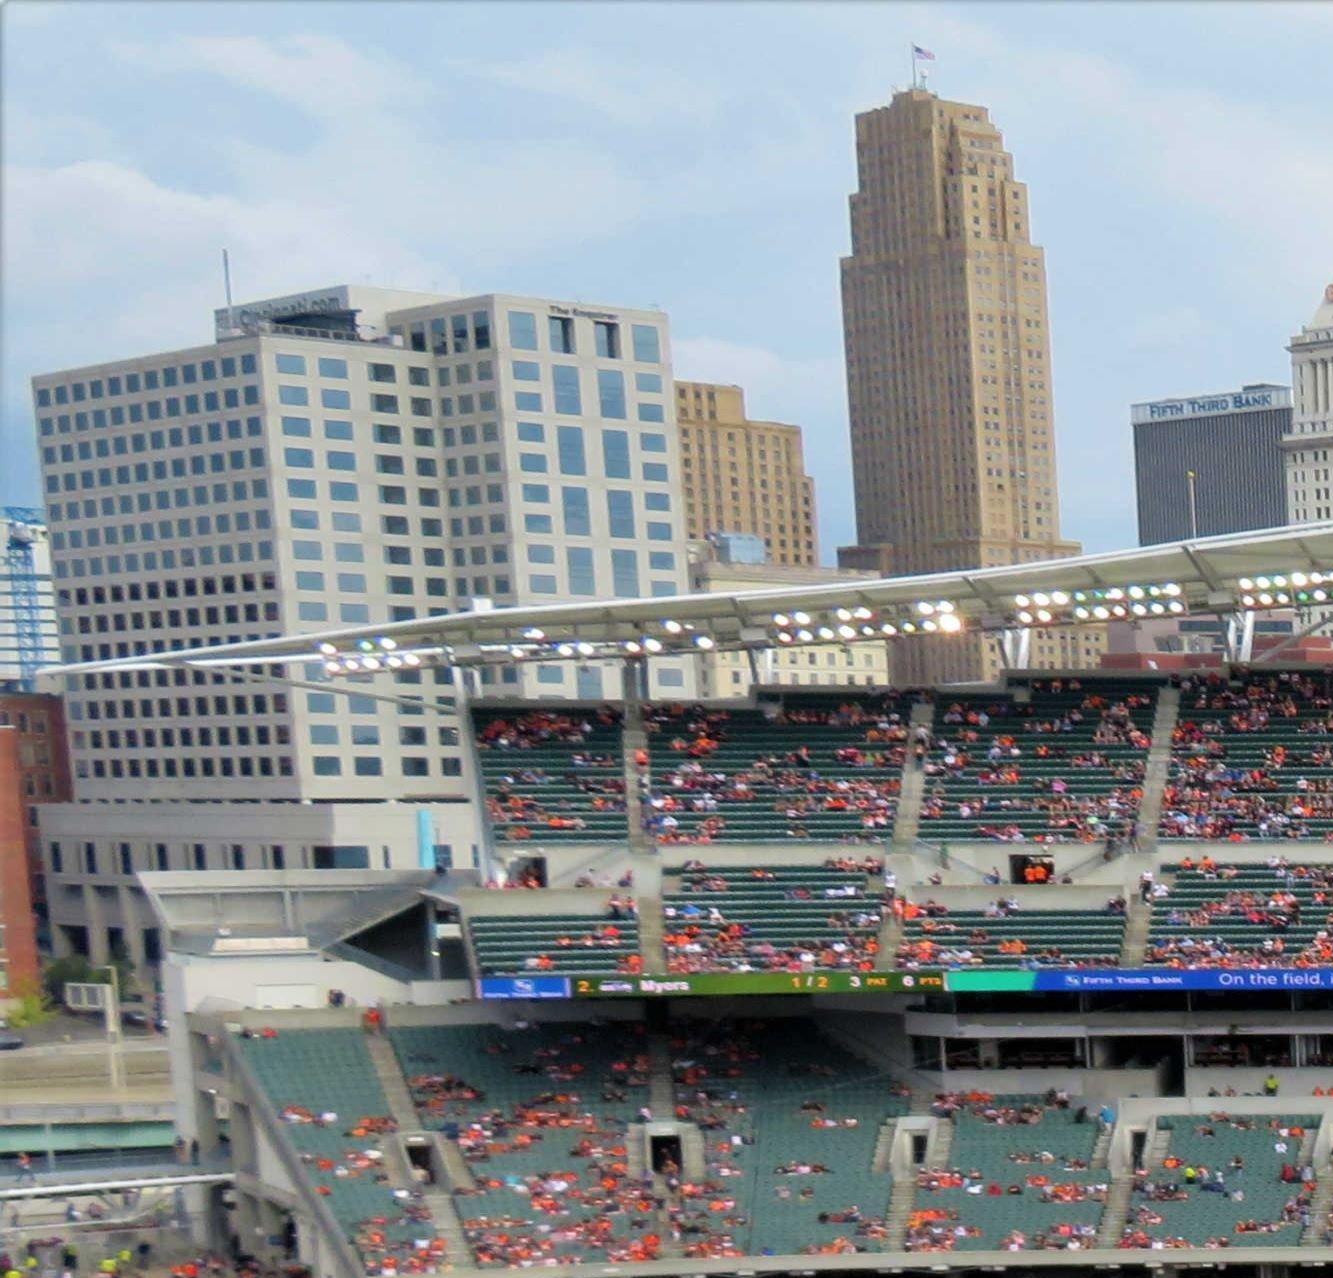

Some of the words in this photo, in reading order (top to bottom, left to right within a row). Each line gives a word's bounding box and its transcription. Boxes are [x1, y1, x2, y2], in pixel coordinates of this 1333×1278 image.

[1150, 404, 1184, 418] FIFTH
[1188, 397, 1228, 415] THIRD
[1233, 391, 1272, 410] BANK
[639, 979, 690, 994] Myers
[850, 976, 861, 988] 3
[1083, 976, 1113, 984] FIFTH
[1117, 976, 1148, 984] THIRD
[1152, 975, 1183, 984] BANK
[1219, 972, 1245, 985] On
[1250, 972, 1278, 985] the
[1283, 972, 1325, 987] field,
